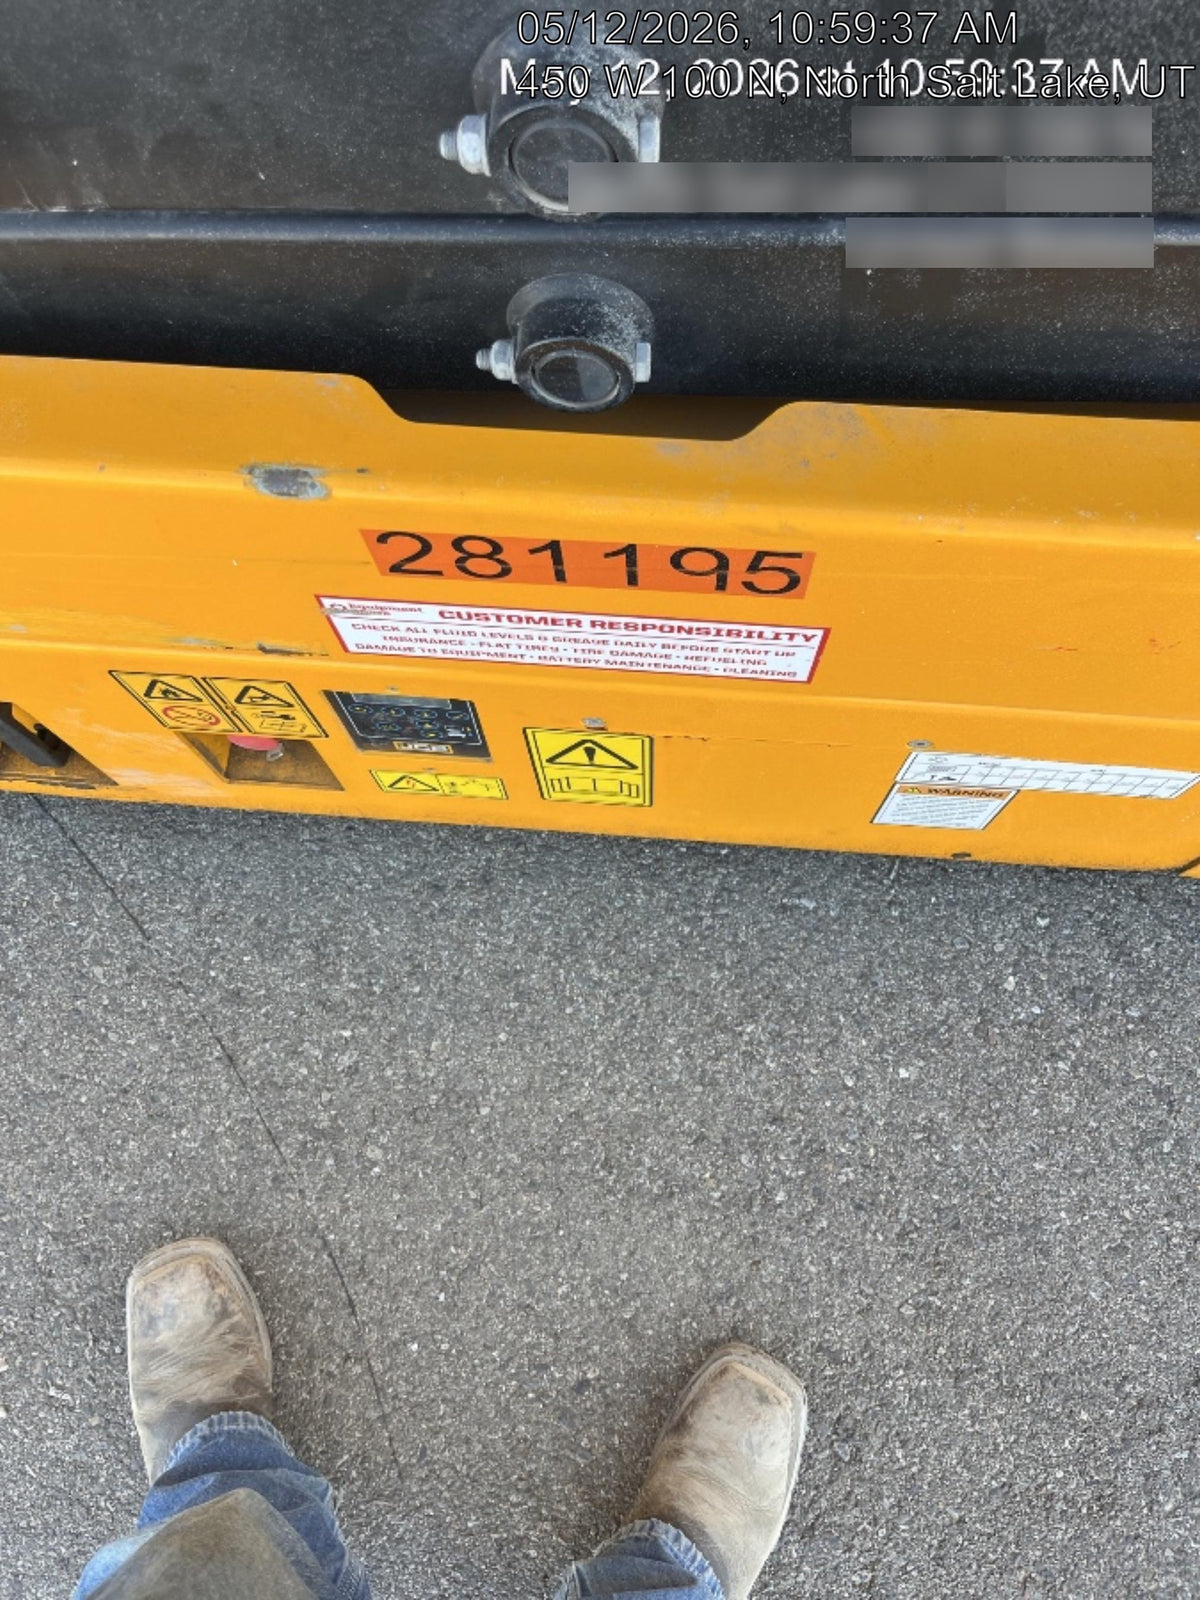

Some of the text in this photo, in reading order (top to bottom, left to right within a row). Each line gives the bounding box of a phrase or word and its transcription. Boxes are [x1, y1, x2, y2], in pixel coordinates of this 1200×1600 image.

[376, 530, 804, 596] 281195
[351, 623, 400, 633] CHECK
[405, 626, 428, 634] ALL
[433, 628, 478, 638] FLUID
[481, 631, 534, 642] LEVELS
[614, 640, 658, 650] DAILY
[661, 643, 719, 653] BEFORE
[723, 647, 772, 656] START
[438, 609, 818, 643] CUSTOMER RESPONSIBILITY
[355, 643, 416, 653] DAMAGE
[441, 648, 527, 660] EQUIPMENT
[538, 655, 601, 665] BATTERY
[605, 659, 711, 672] MAINTENANCE
[723, 667, 798, 678] CLEANING
[382, 635, 466, 647] INSURANCE
[478, 641, 511, 650] FLAT
[517, 643, 560, 653] TIRES
[609, 651, 673, 660] DAMAGE
[684, 655, 768, 666] REFUELING
[927, 786, 1004, 798] WARNING
